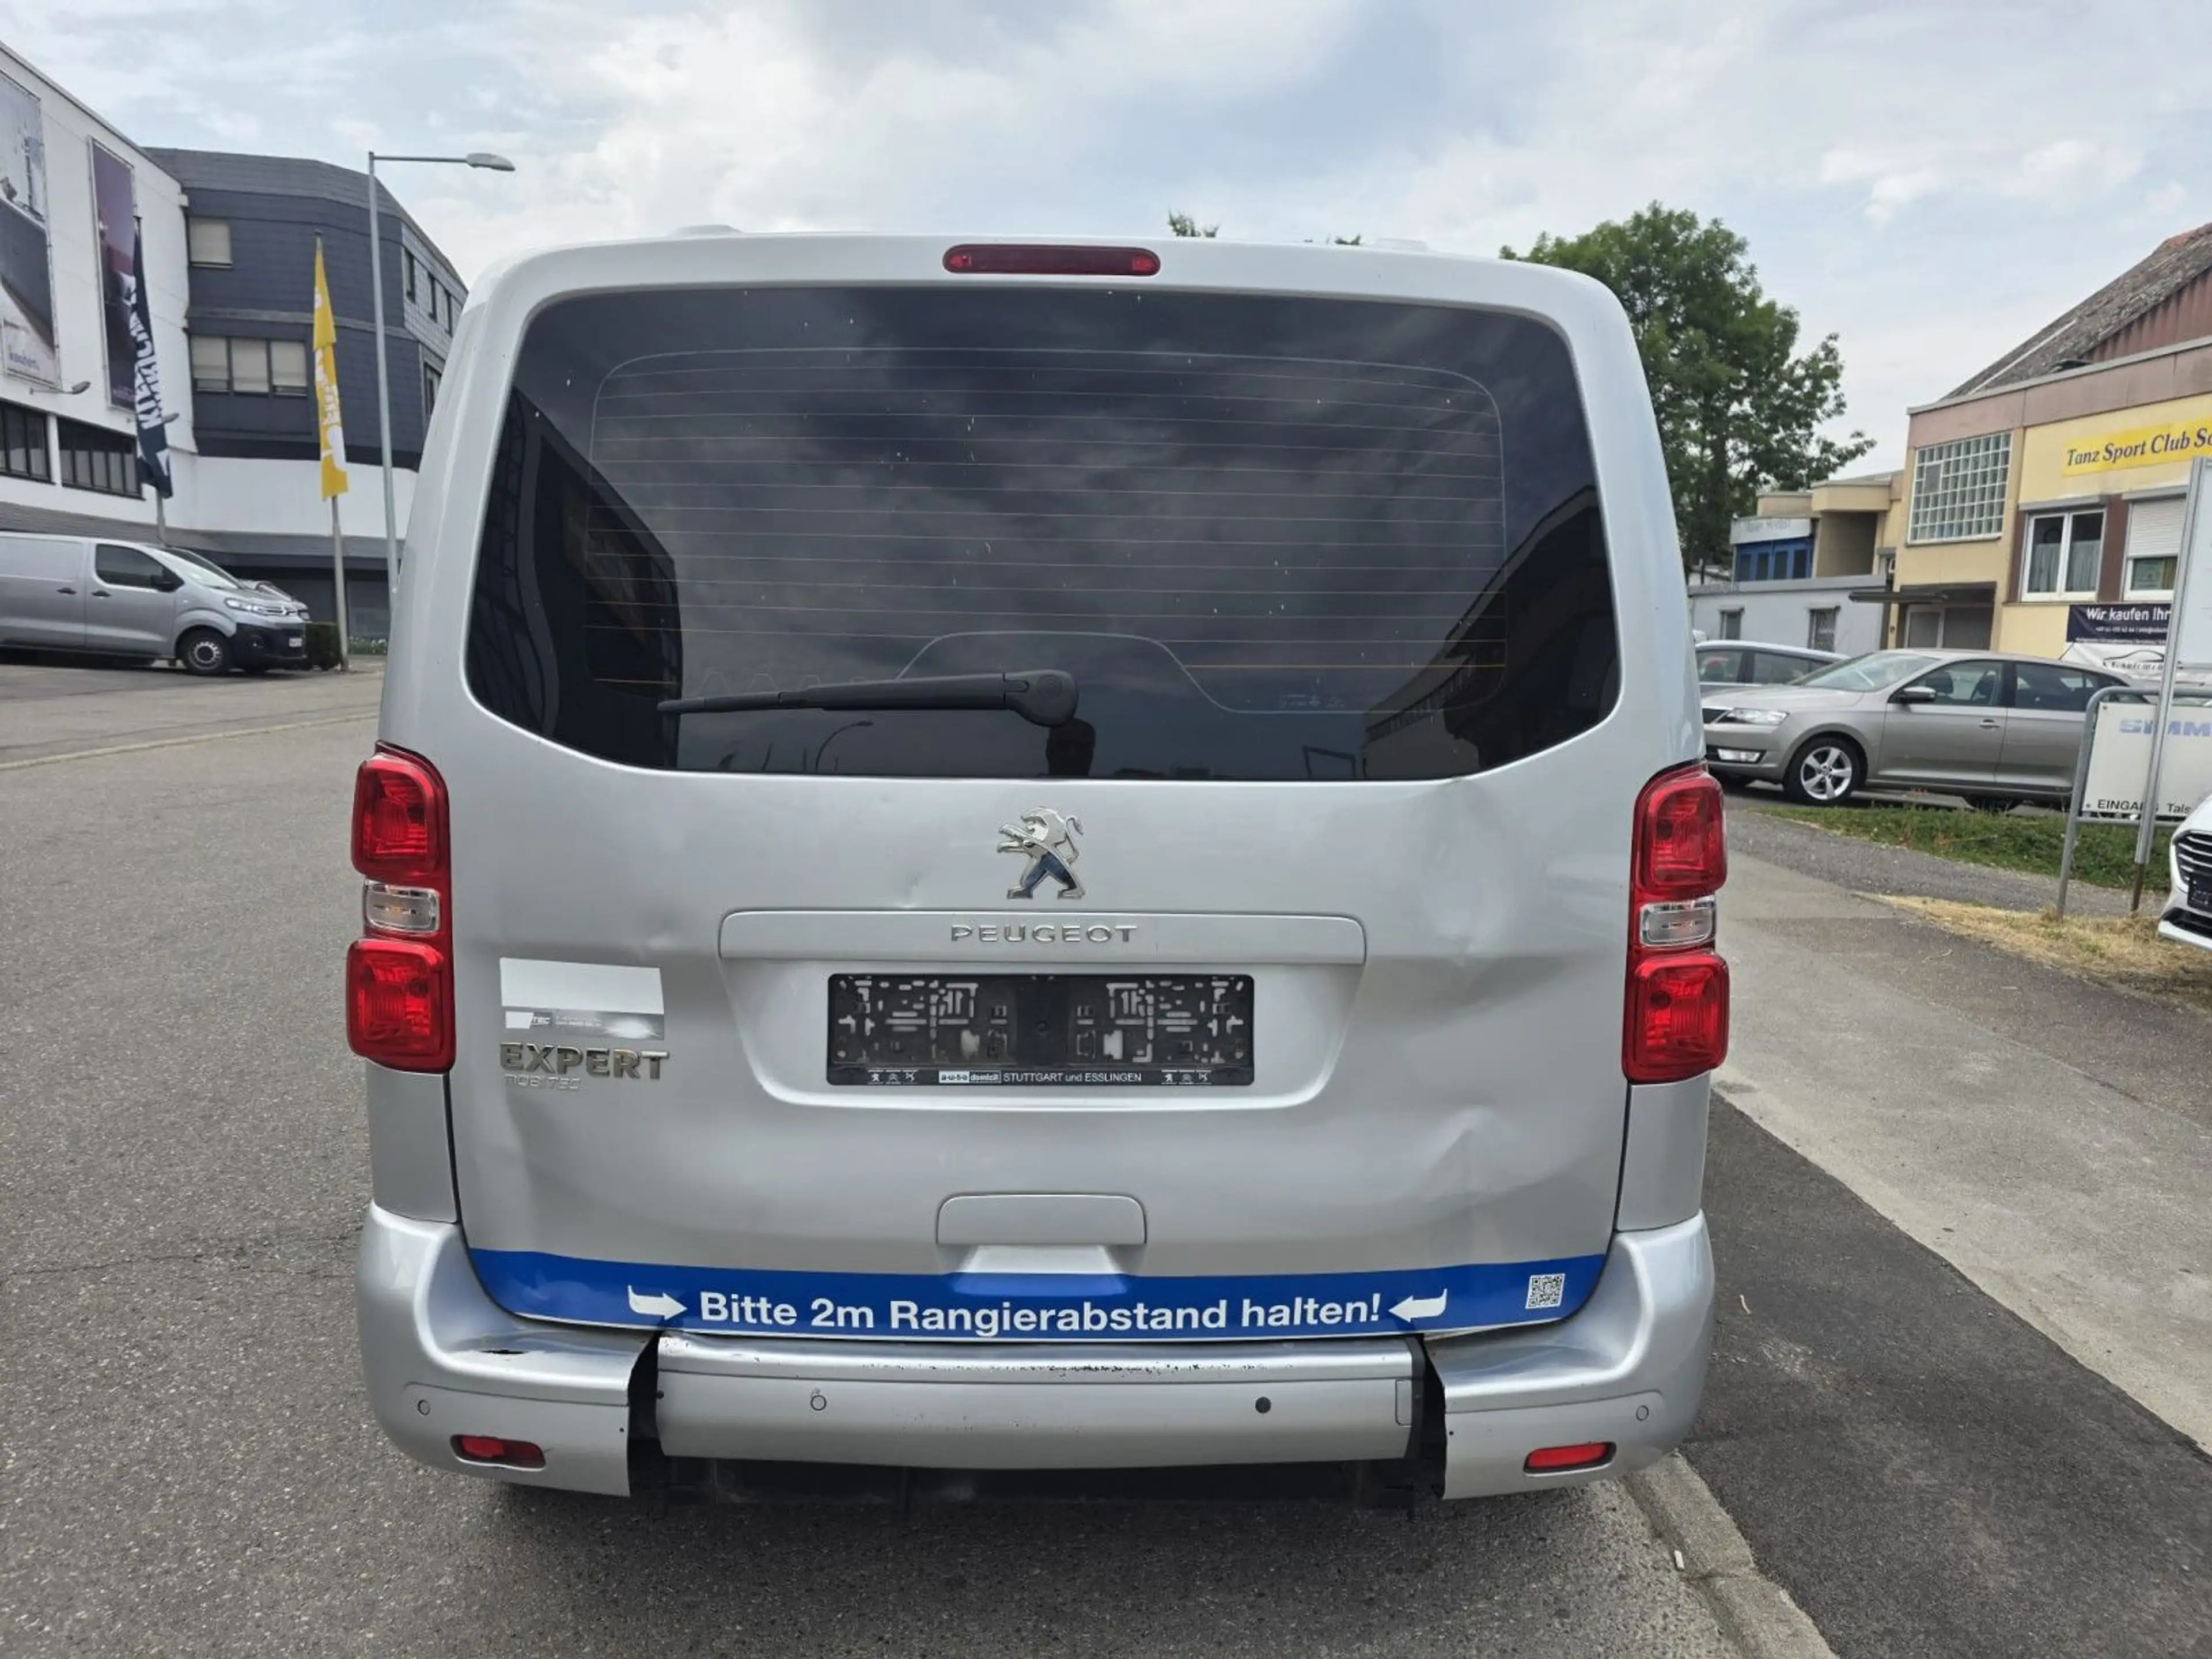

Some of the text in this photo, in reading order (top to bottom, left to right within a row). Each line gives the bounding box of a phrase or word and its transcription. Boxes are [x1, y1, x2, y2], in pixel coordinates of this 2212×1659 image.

[2067, 449, 2100, 466] Tanz
[2103, 441, 2146, 463] Sport
[2151, 431, 2191, 454] Club
[2086, 608, 2107, 620] Wir
[2109, 607, 2149, 621] kaufen
[2097, 799, 2159, 812] EINGA
[951, 924, 1138, 943] PEUGEOT
[500, 1042, 669, 1080] EXPERT
[1003, 1072, 1064, 1082] STUTTGART
[1066, 1073, 1082, 1082] und
[1085, 1072, 1141, 1082] ESSLINGEN
[700, 1291, 1381, 1336] Bitte 2m Rangierabstand halten!
